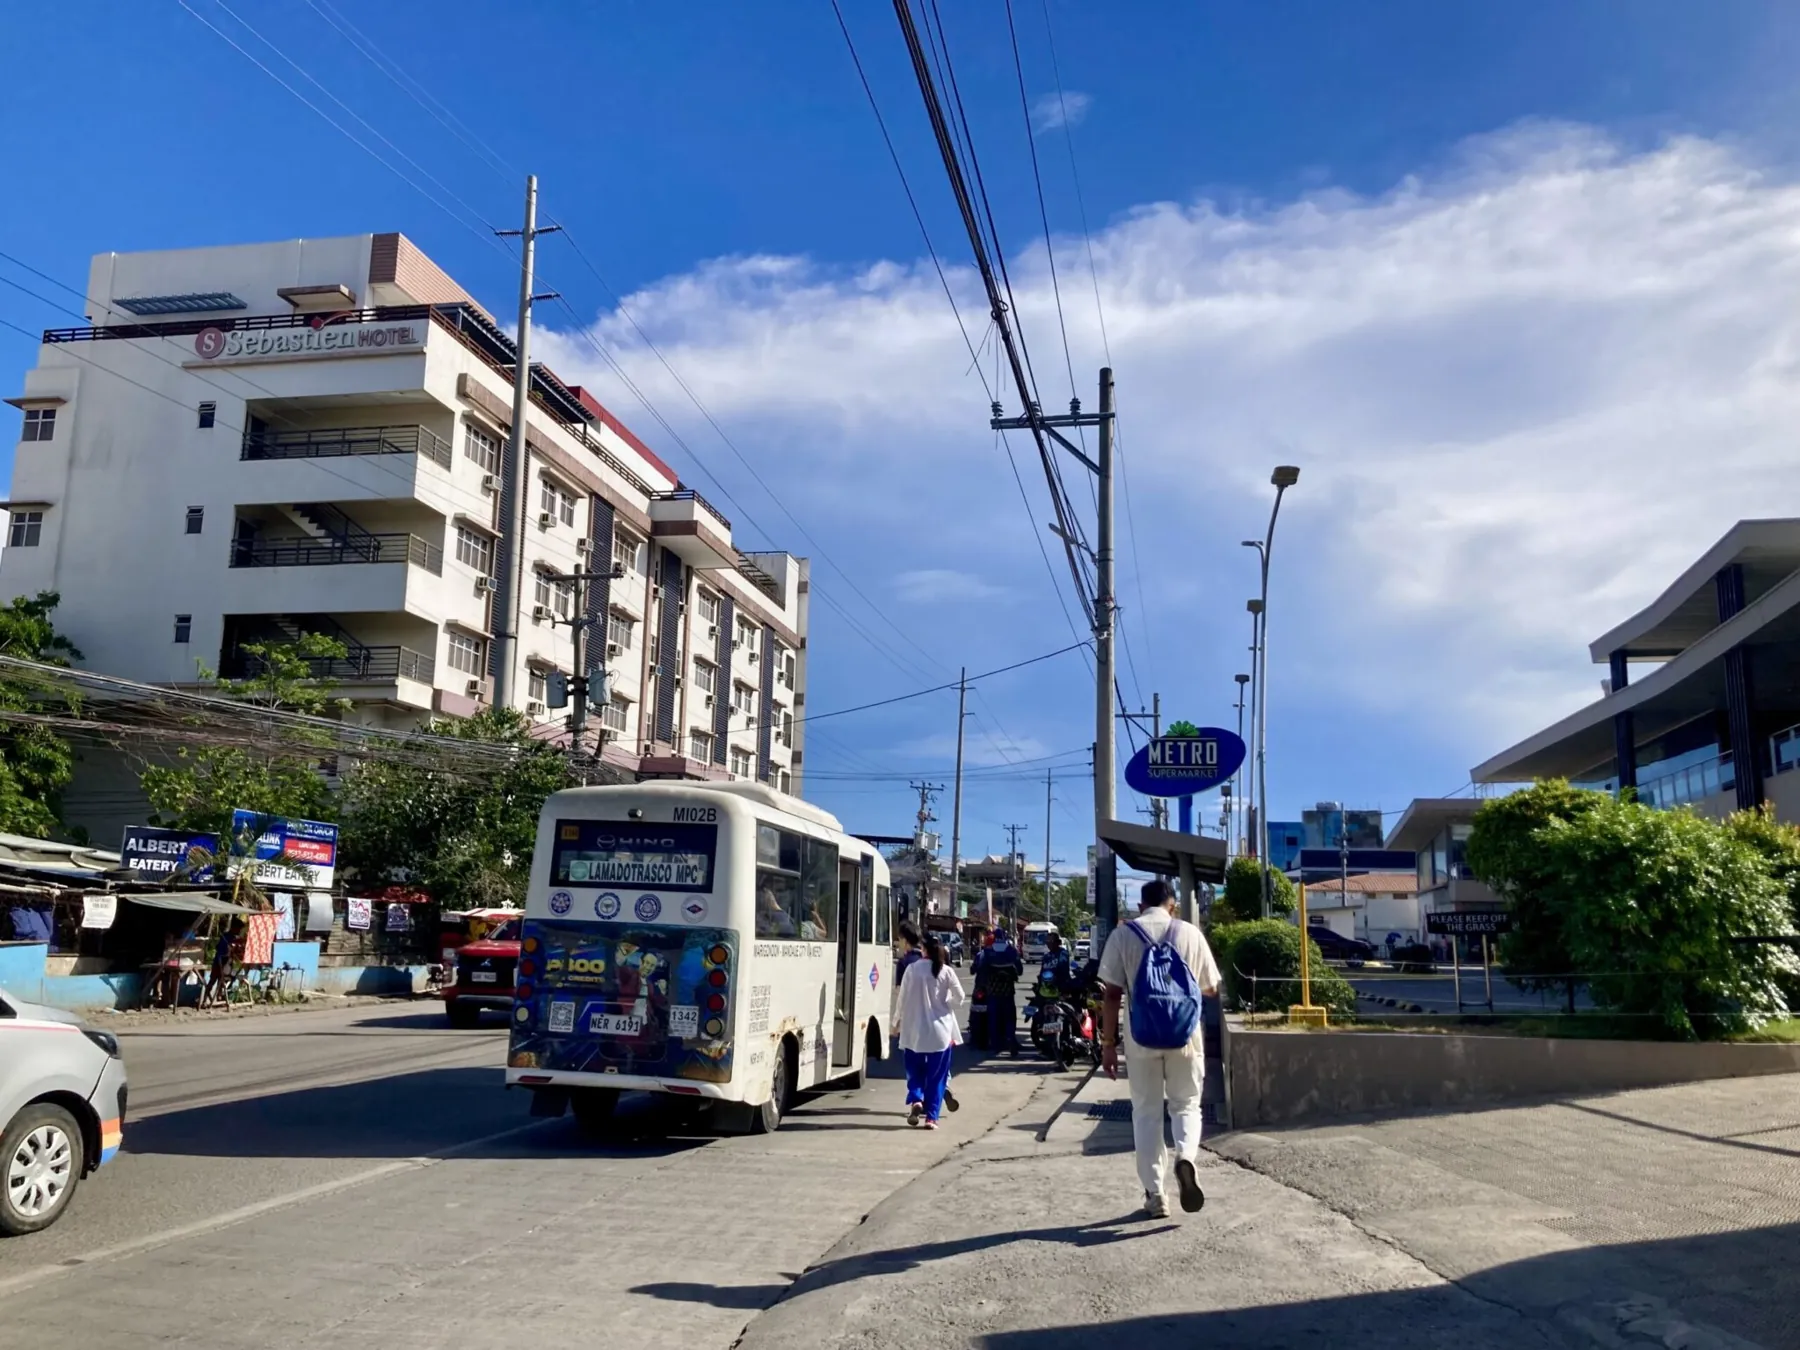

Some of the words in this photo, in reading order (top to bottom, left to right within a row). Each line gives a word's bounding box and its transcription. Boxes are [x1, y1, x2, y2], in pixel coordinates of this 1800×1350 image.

[226, 330, 356, 356] Sebastien
[357, 326, 419, 347] HOTEL
[1149, 741, 1218, 764] METRO
[1147, 769, 1218, 778] SUPERMARKET
[673, 807, 717, 822] MI02B
[126, 838, 188, 854] ALBERT
[129, 858, 179, 872] EATERY
[588, 862, 672, 883] LAMADOTRASCO
[675, 864, 698, 884] MPC
[1430, 914, 1464, 924] PLEASE
[1465, 914, 1489, 923] KEEP
[1490, 913, 1508, 923] OFF
[1446, 923, 1463, 932] THE
[1465, 923, 1497, 932] GRASS
[671, 1010, 697, 1022] 1342
[591, 1017, 608, 1031] NER
[615, 1020, 640, 1033] 6191
